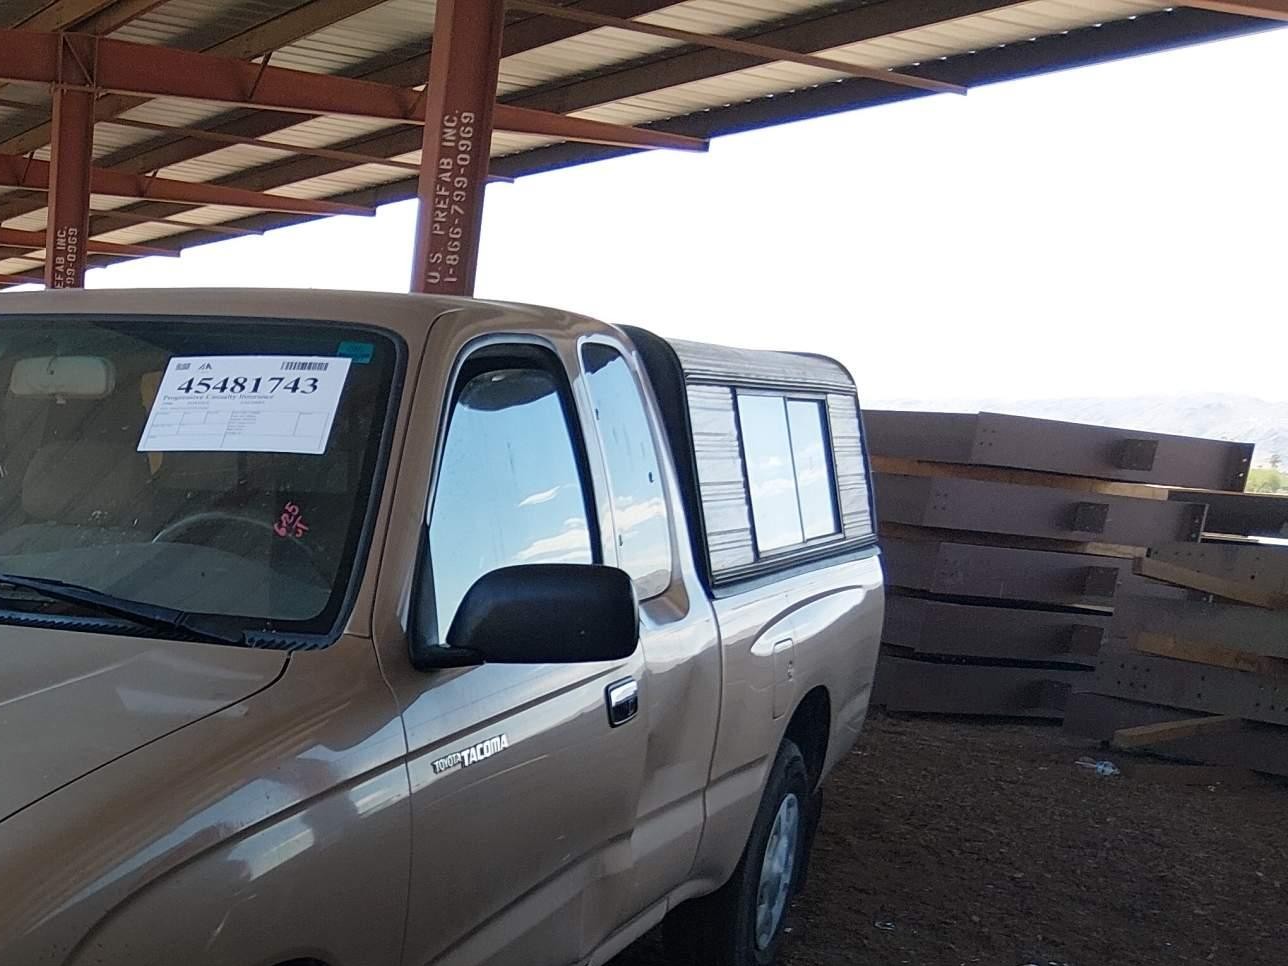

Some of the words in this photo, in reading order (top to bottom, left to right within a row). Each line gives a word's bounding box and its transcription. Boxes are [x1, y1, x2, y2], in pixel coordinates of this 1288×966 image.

[441, 109, 460, 147] INC.
[432, 158, 454, 236] PREFAB
[444, 111, 475, 283] 1-866-799-0969
[55, 256, 65, 288] EFAB
[177, 377, 318, 394] 45481743
[434, 753, 461, 773] TOYOTA
[461, 734, 508, 767] TACOMA
